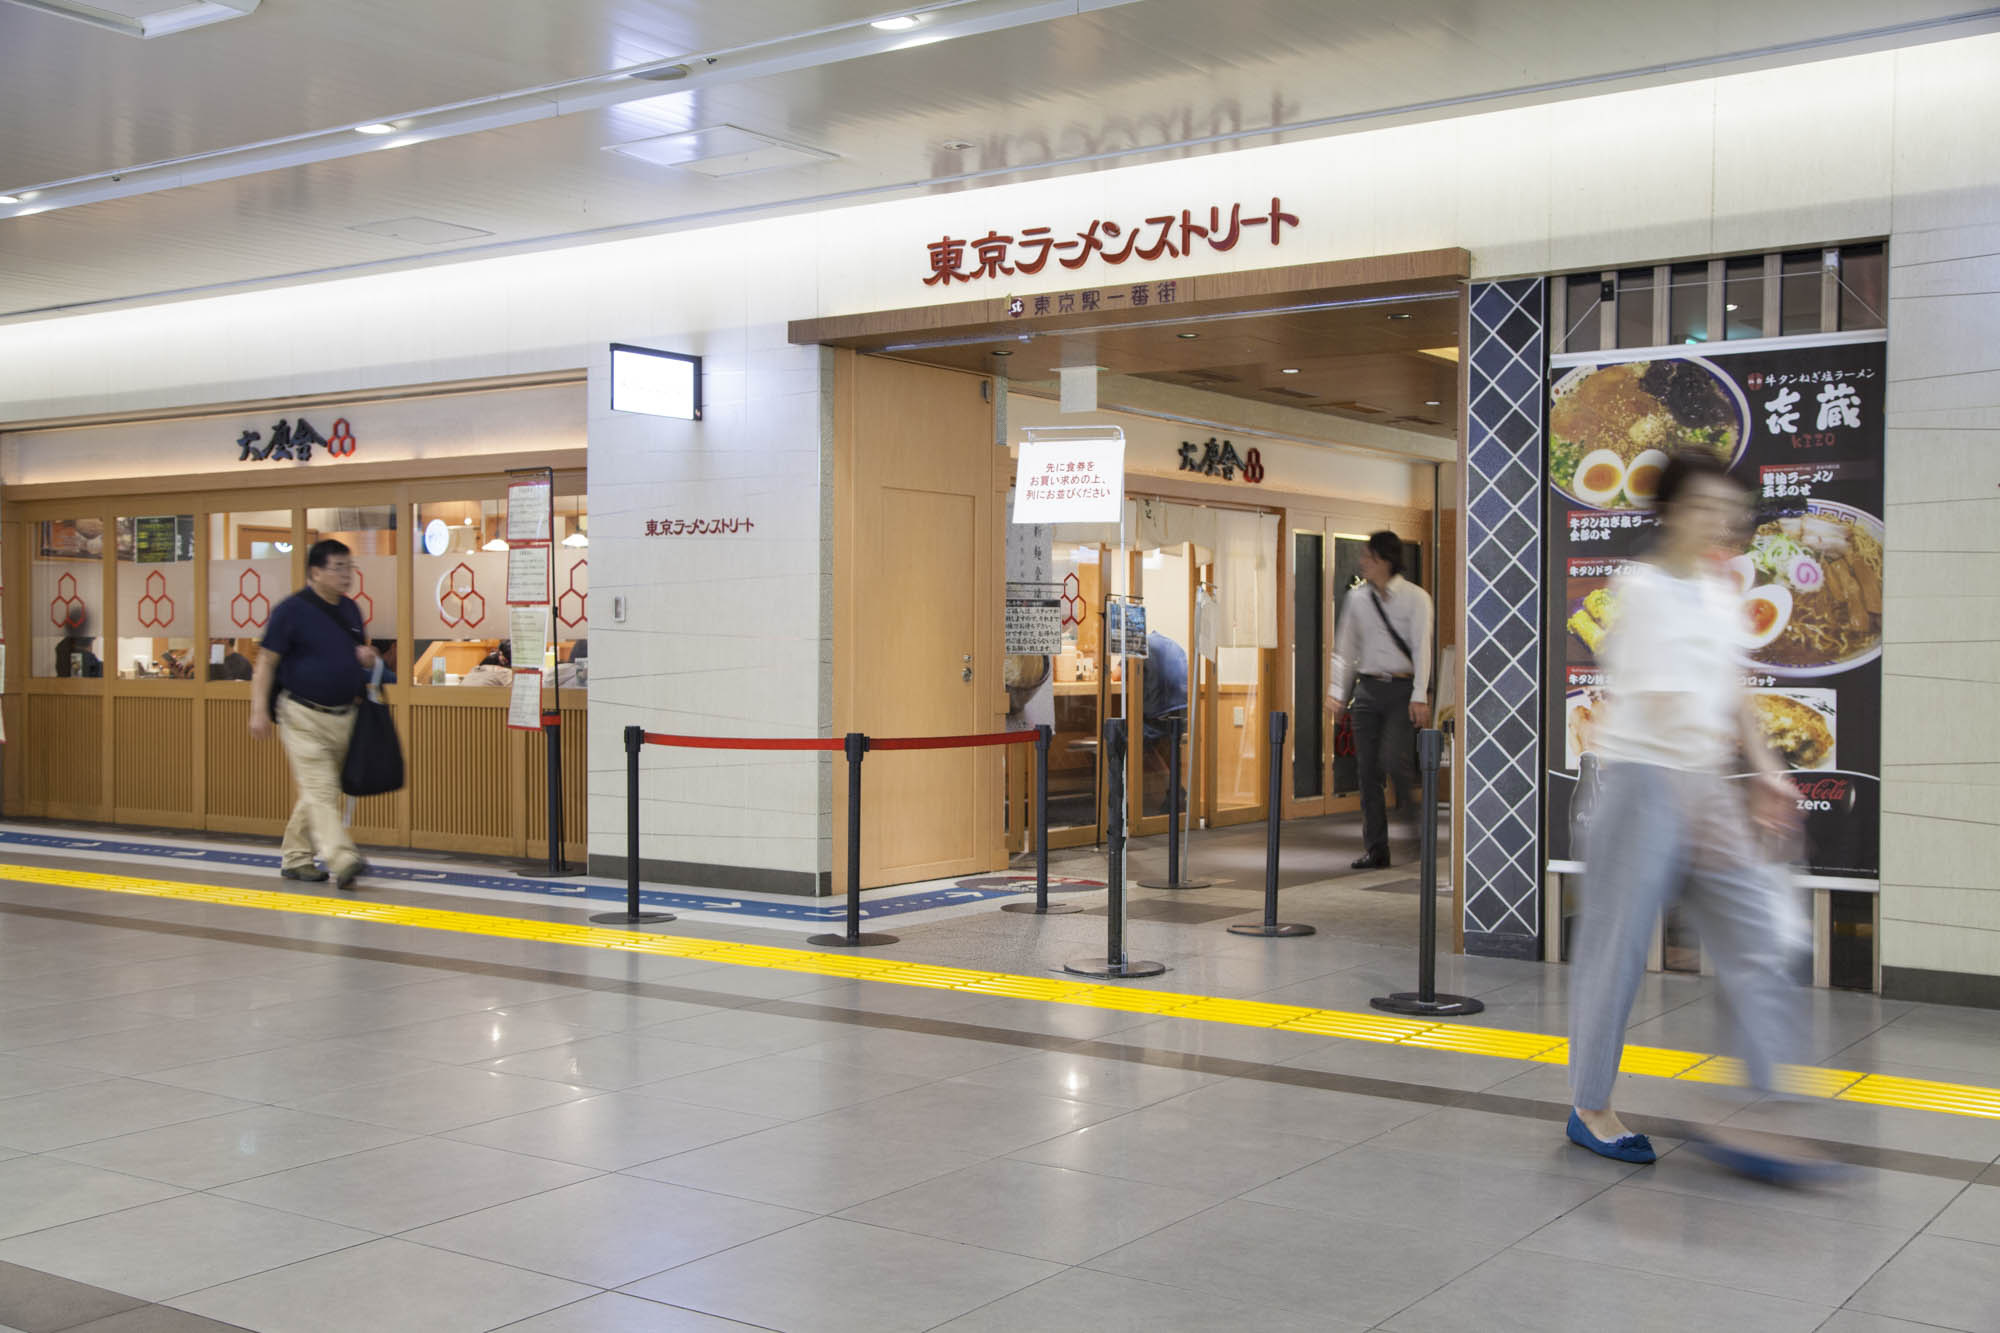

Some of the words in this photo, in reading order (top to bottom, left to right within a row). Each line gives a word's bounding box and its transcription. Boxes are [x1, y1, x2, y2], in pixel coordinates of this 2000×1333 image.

[923, 197, 1300, 287] 東京ラーメンストリート
[1765, 368, 1876, 387] 牛タンねぎ塩ラーメン
[1046, 461, 1095, 473] 先に食券を
[1026, 488, 1111, 500] 列にお並びください
[644, 517, 755, 537] 東京ラーメンストリート
[1569, 515, 1666, 530] 牛タンねぎ塩ラーメ
[1796, 799, 1831, 811] zero
